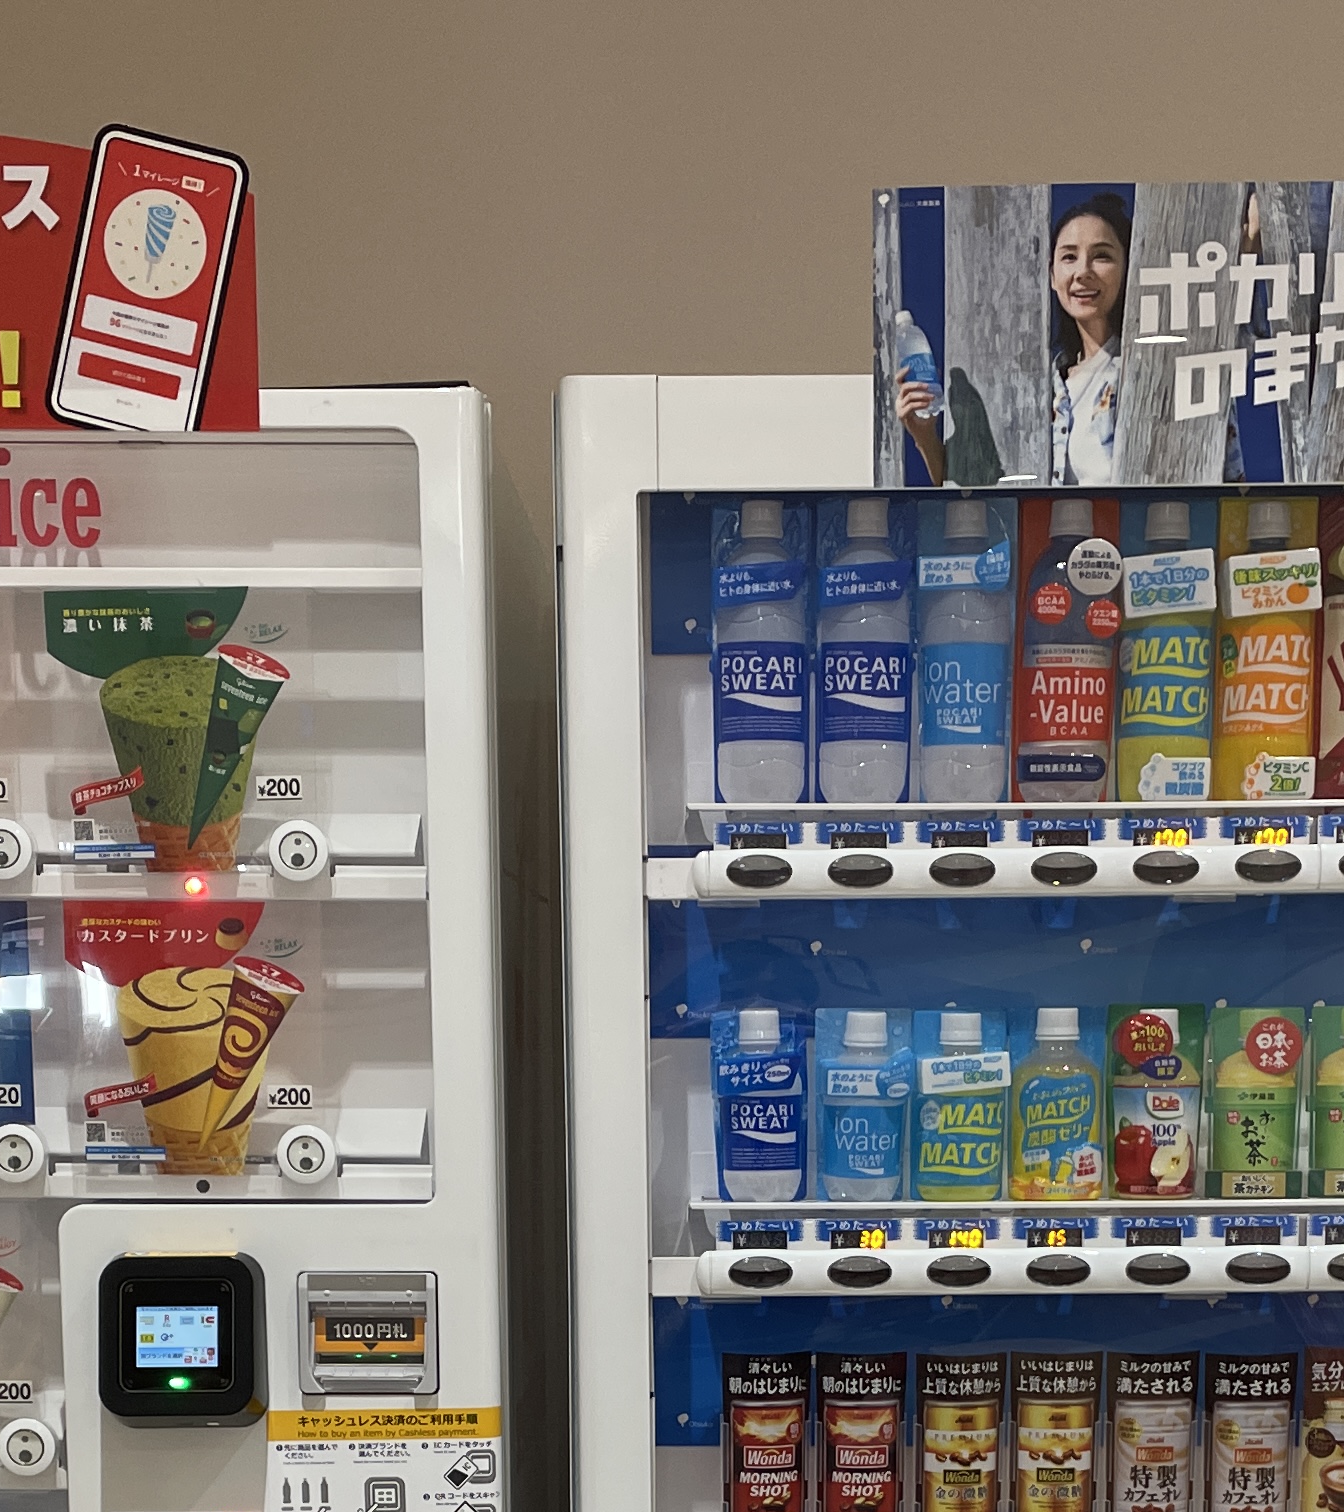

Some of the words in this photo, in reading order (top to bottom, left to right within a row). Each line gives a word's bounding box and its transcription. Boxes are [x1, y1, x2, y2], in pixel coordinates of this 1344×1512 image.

[923, 561, 972, 573] 水のように
[1242, 586, 1284, 599] ビタミン
[1038, 596, 1065, 605] BCAA
[1252, 596, 1286, 608] みかん
[62, 617, 153, 633] 濃い抹茶
[721, 656, 802, 673] POCARI
[825, 656, 906, 673] POCARI
[924, 656, 960, 680] ion
[721, 675, 796, 691] SWEAT
[825, 675, 901, 691] SWEAT
[1031, 671, 1106, 697] Amino
[924, 681, 1001, 705] water
[1030, 699, 1104, 725] -Value
[1050, 726, 1088, 736] BCAA
[1264, 762, 1310, 774] ビタミンC
[258, 779, 300, 798] ¥200
[81, 928, 208, 944] カスタードプリン
[720, 1060, 760, 1077] 飲みきり
[730, 1074, 764, 1087] サイズ
[269, 1088, 311, 1106] ¥200
[1153, 1096, 1179, 1108] Dole
[731, 1104, 794, 1116] POCARI
[1027, 1095, 1090, 1120] MATCH
[731, 1117, 788, 1129] SWEAT
[835, 1111, 868, 1134] ion
[835, 1132, 898, 1151] water
[1152, 1138, 1176, 1146] Apple
[1241, 1116, 1268, 1166] お茶
[334, 1324, 407, 1339] 1000円札
[927, 1362, 998, 1374] いいはじまりは
[1120, 1361, 1192, 1374] ミルクの甘みで
[729, 1377, 806, 1394] 朝のはじまりに
[1116, 1378, 1193, 1395] 満たされる
[298, 1414, 478, 1426] キャッシュレス決済のご利用手順
[331, 1430, 346, 1438] buy
[364, 1429, 383, 1437] item
[386, 1429, 395, 1438] by
[399, 1429, 435, 1437] Cashless
[747, 1450, 792, 1465] Wonda
[840, 1450, 885, 1465] Wonda
[740, 1471, 798, 1483] MORNING
[945, 1471, 979, 1483] Wonda
[1130, 1465, 1177, 1487] 特製
[750, 1485, 789, 1497] SHOT
[1124, 1488, 1181, 1503] カフェオレ
